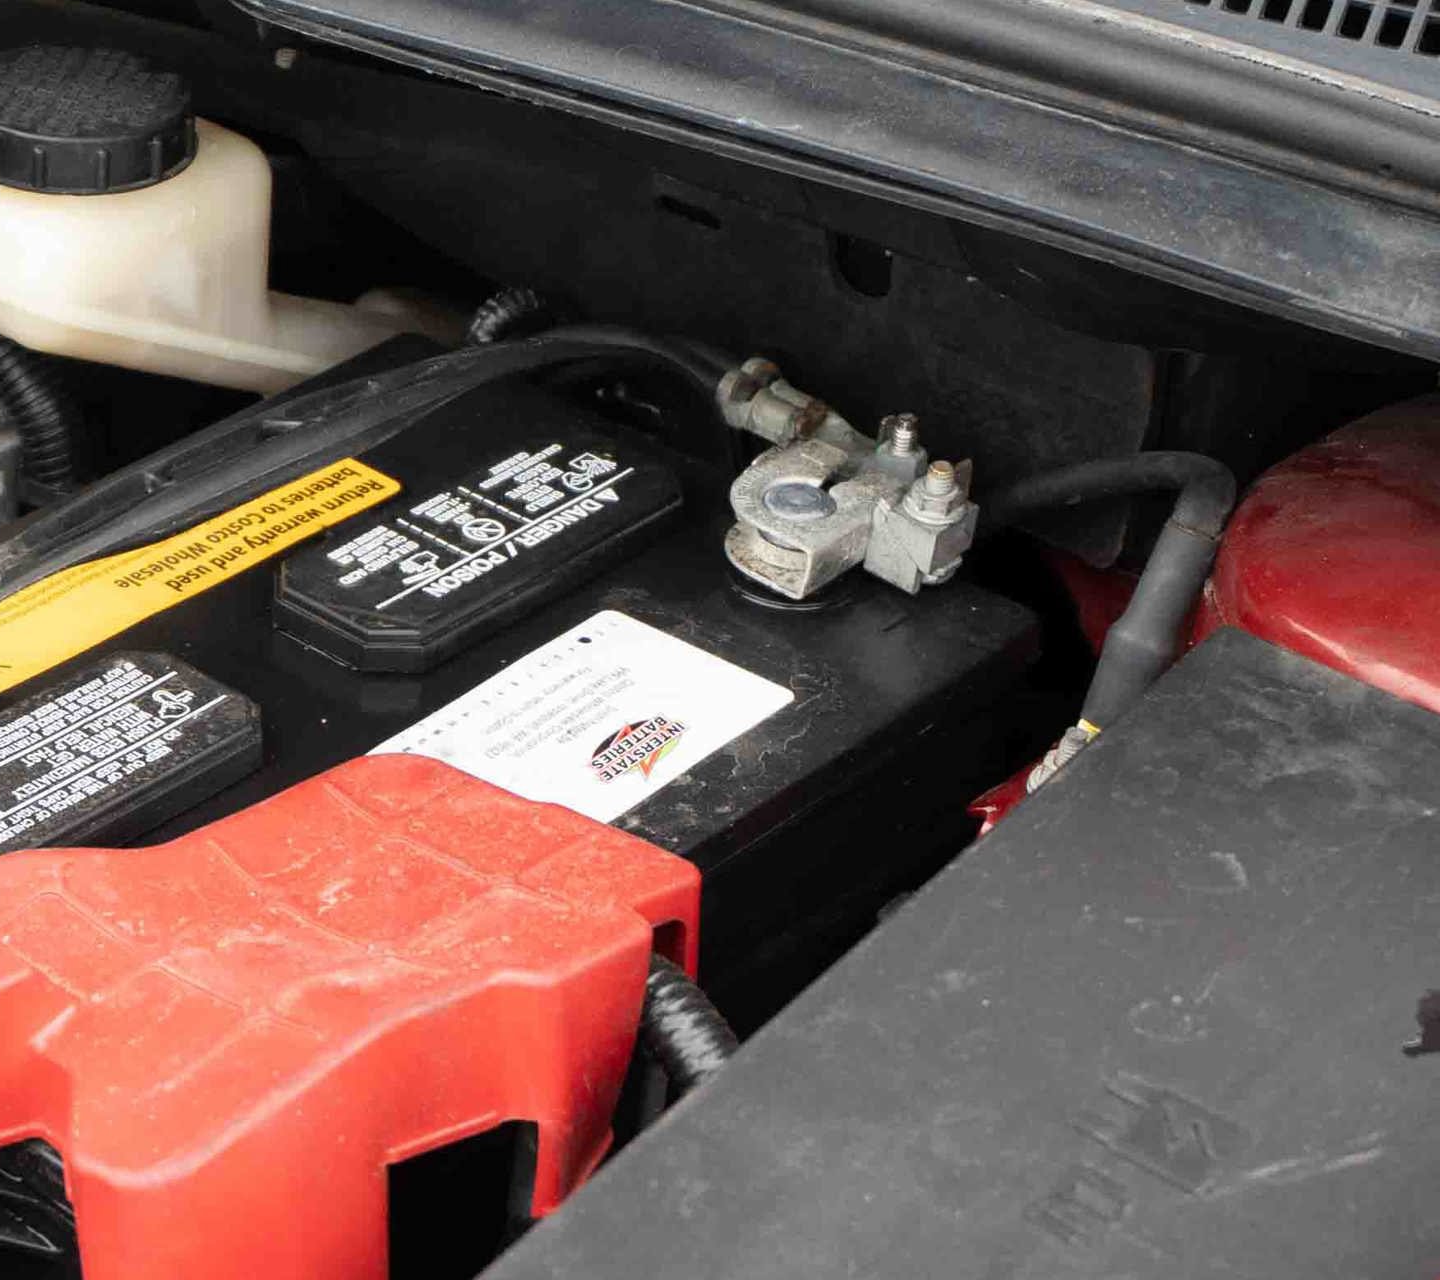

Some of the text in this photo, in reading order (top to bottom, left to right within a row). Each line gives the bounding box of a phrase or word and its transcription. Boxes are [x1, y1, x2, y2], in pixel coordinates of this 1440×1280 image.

[115, 467, 361, 587] batteries to Costco Wholesale
[165, 480, 384, 592] Return warranty and used
[515, 499, 602, 546] DANGER
[423, 551, 506, 597] POISON
[21, 703, 139, 767] MEDICAL HELP FAST
[116, 710, 152, 730] WITH
[163, 729, 182, 740] DO
[592, 717, 667, 768] BATTERIES
[12, 717, 165, 800] FLUSH EYES IMMEDIATELY
[46, 751, 75, 768] GET
[142, 738, 166, 753] NOT
[600, 723, 684, 780] INTERSTATE
[49, 791, 86, 812] REACH
